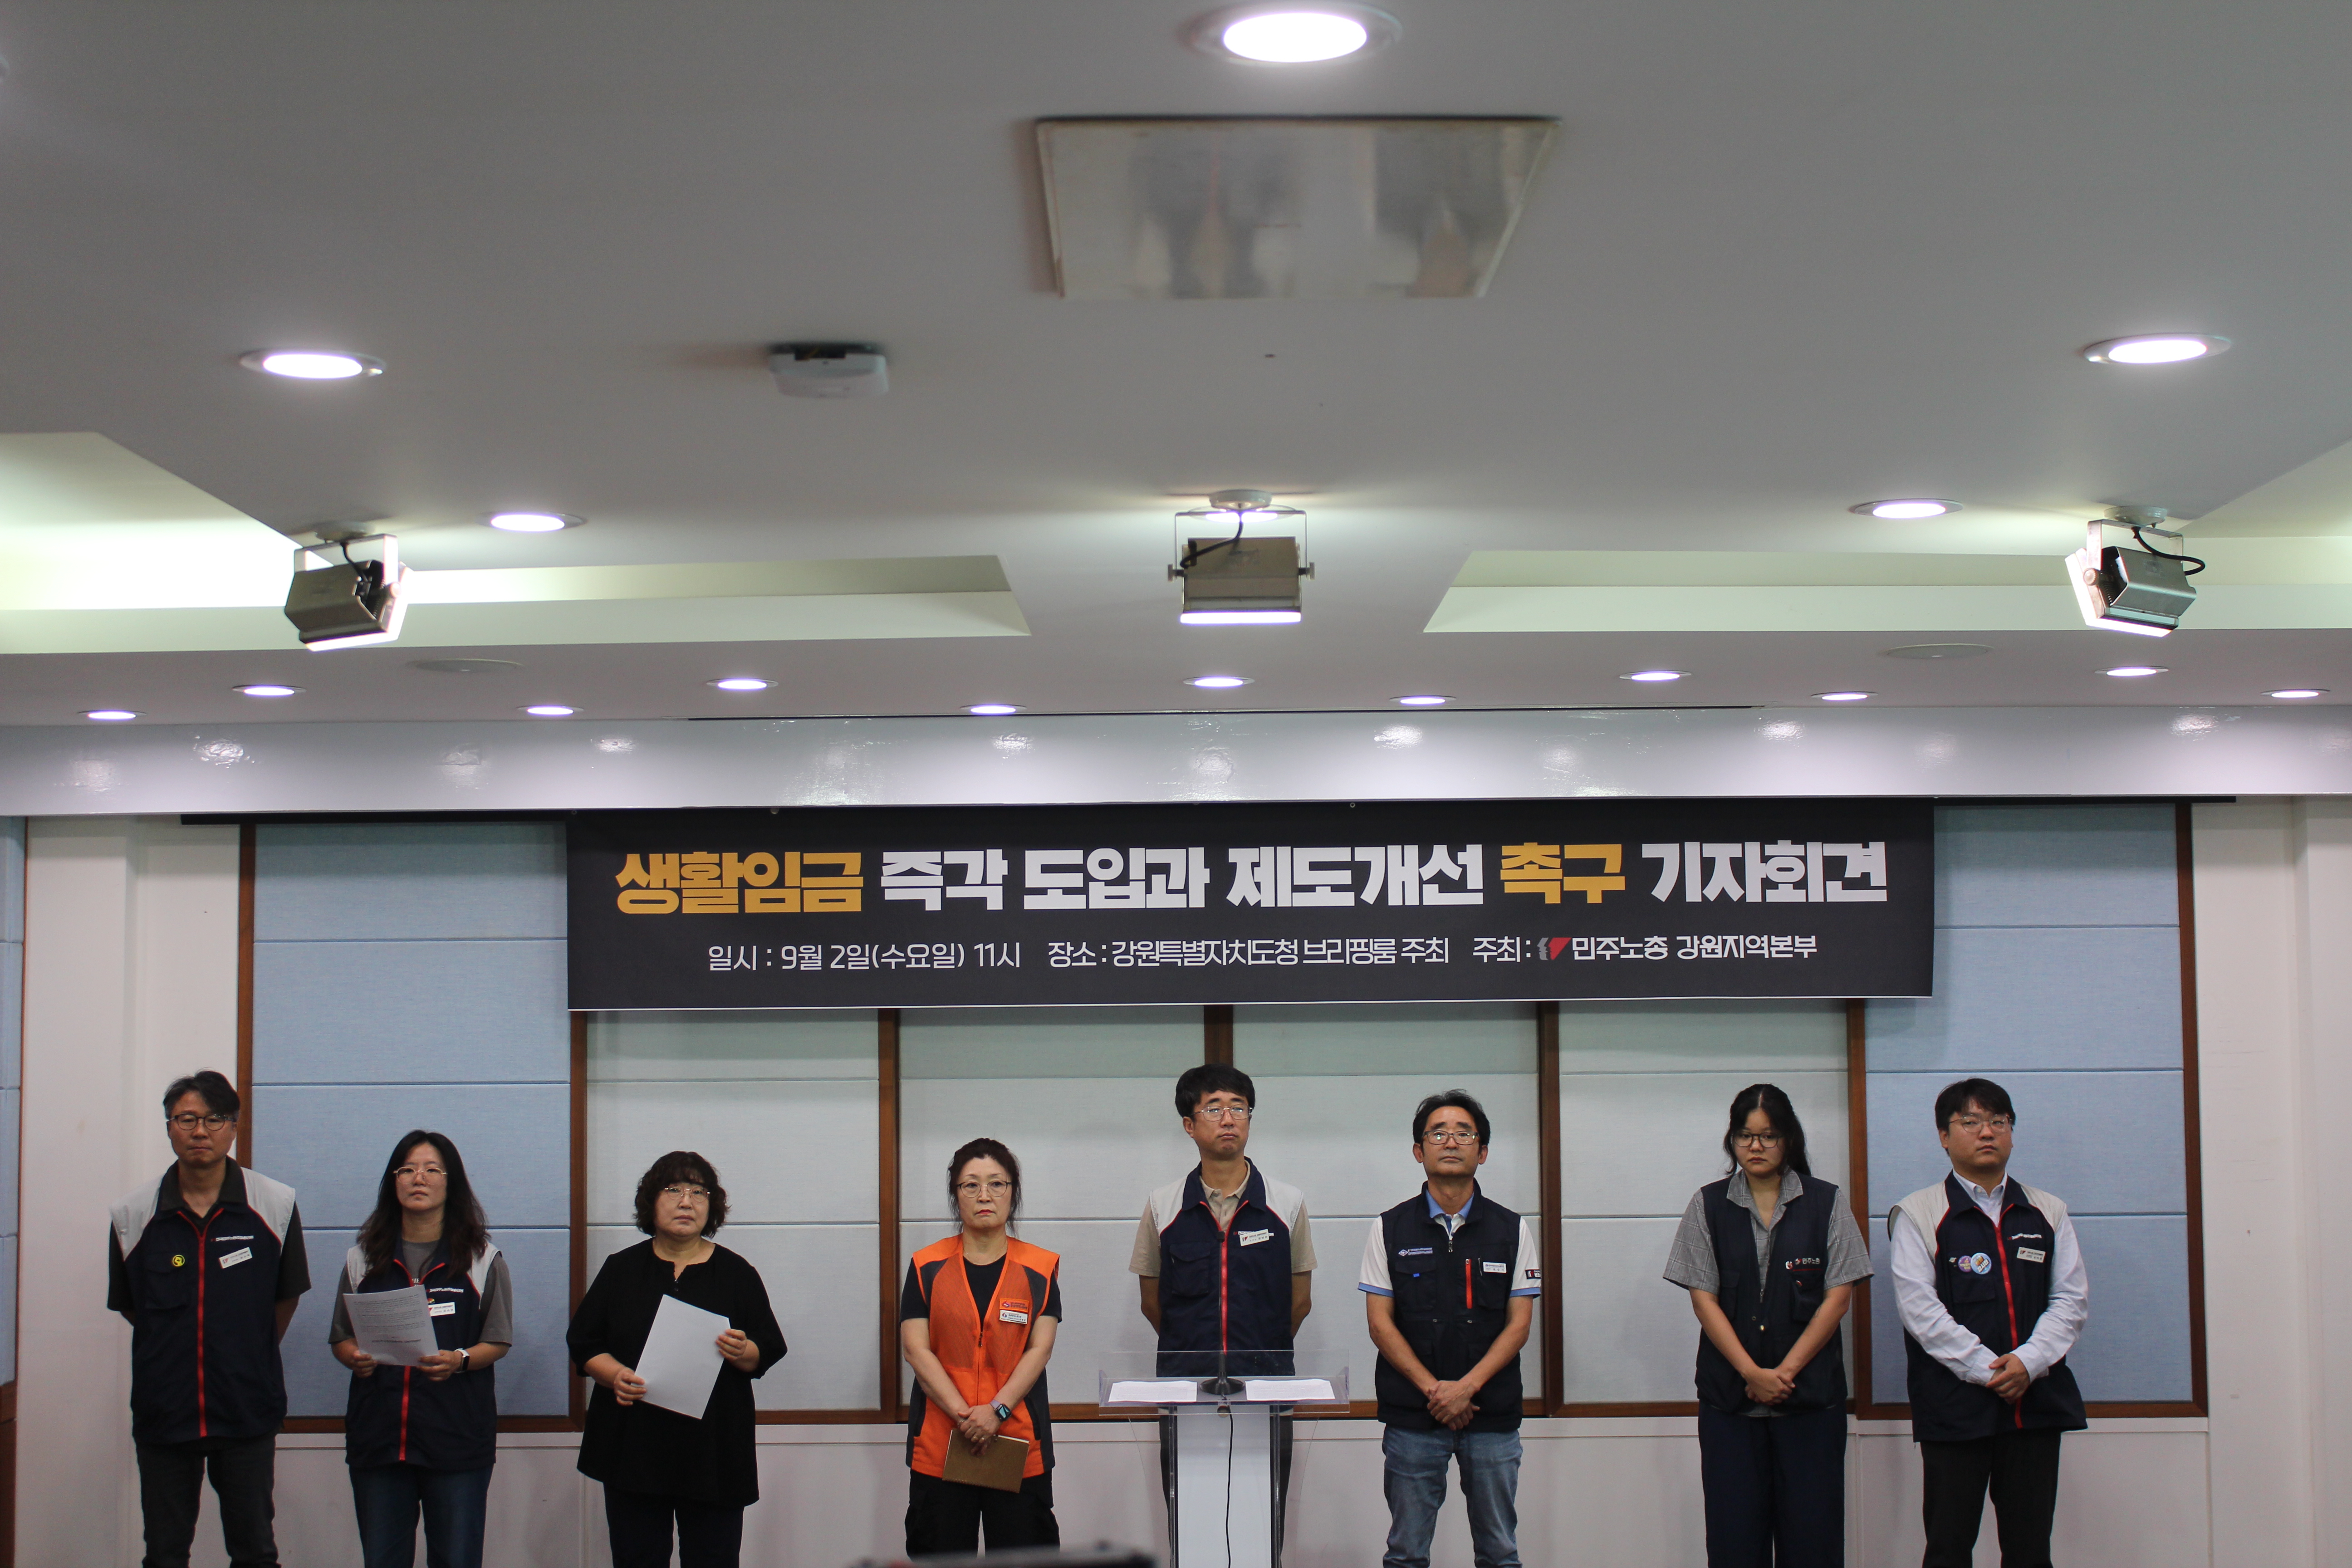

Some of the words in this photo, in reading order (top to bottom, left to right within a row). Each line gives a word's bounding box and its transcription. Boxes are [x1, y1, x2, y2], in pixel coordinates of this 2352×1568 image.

[616, 852, 864, 915] 생활임금
[881, 849, 1009, 911] 즉각
[1024, 848, 1210, 910] 도입과
[1226, 844, 1484, 908] 제도개선
[1500, 843, 1626, 904] 촉구
[1642, 840, 1888, 903] 기자회견
[782, 945, 822, 971] 9월
[831, 943, 965, 970] 2일(수요일)
[974, 942, 1020, 968] 11시
[1303, 938, 1398, 965] 브리핑룸
[1401, 937, 1449, 964] 주최
[1572, 936, 1669, 961] 민주노총
[1676, 935, 1818, 960] 강원지역본부
